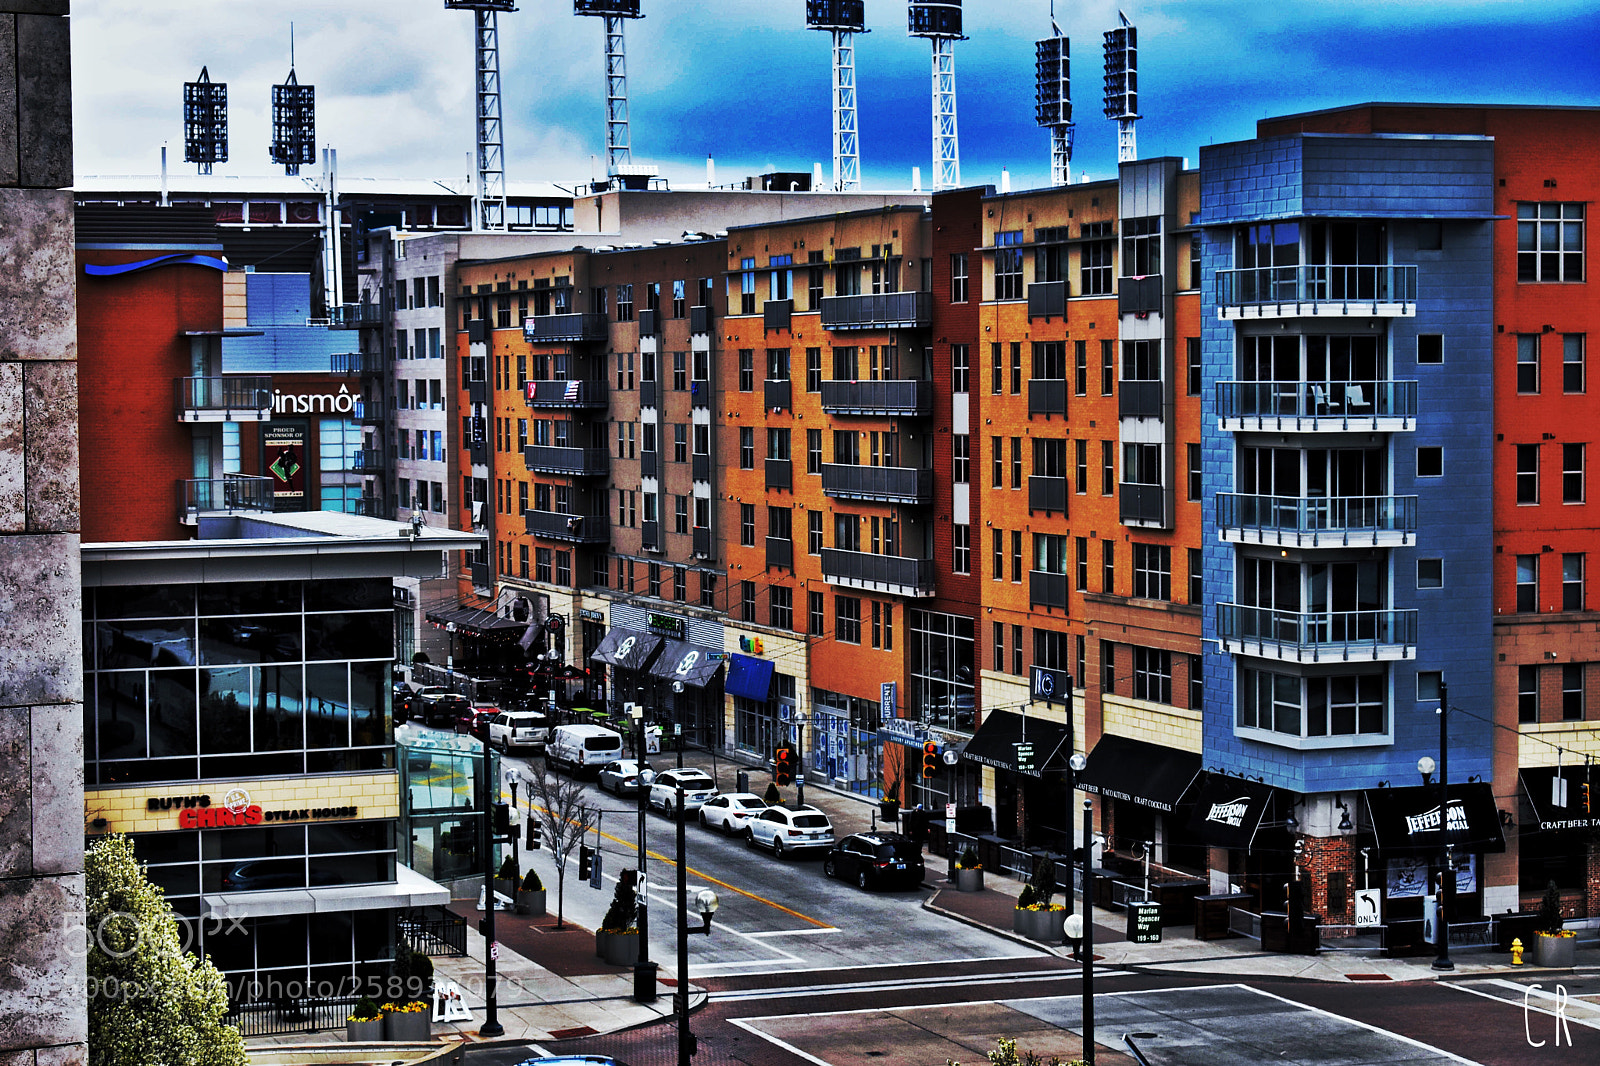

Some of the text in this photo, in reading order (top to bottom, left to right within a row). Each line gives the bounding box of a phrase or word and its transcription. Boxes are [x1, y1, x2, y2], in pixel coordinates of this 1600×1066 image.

[147, 794, 211, 811] RUTH'S
[1134, 796, 1148, 806] CRAFT
[1147, 799, 1172, 812] COCKTAILS
[178, 804, 263, 829] CHRIS
[264, 806, 358, 822] STEAK HOUSE
[1205, 803, 1249, 821] JEFFERSON
[1540, 820, 1567, 830] CRAFT
[1567, 819, 1588, 828] BEER
[1138, 907, 1158, 915] Marian
[1357, 914, 1379, 924] ONLY
[1137, 923, 1150, 931] Way
